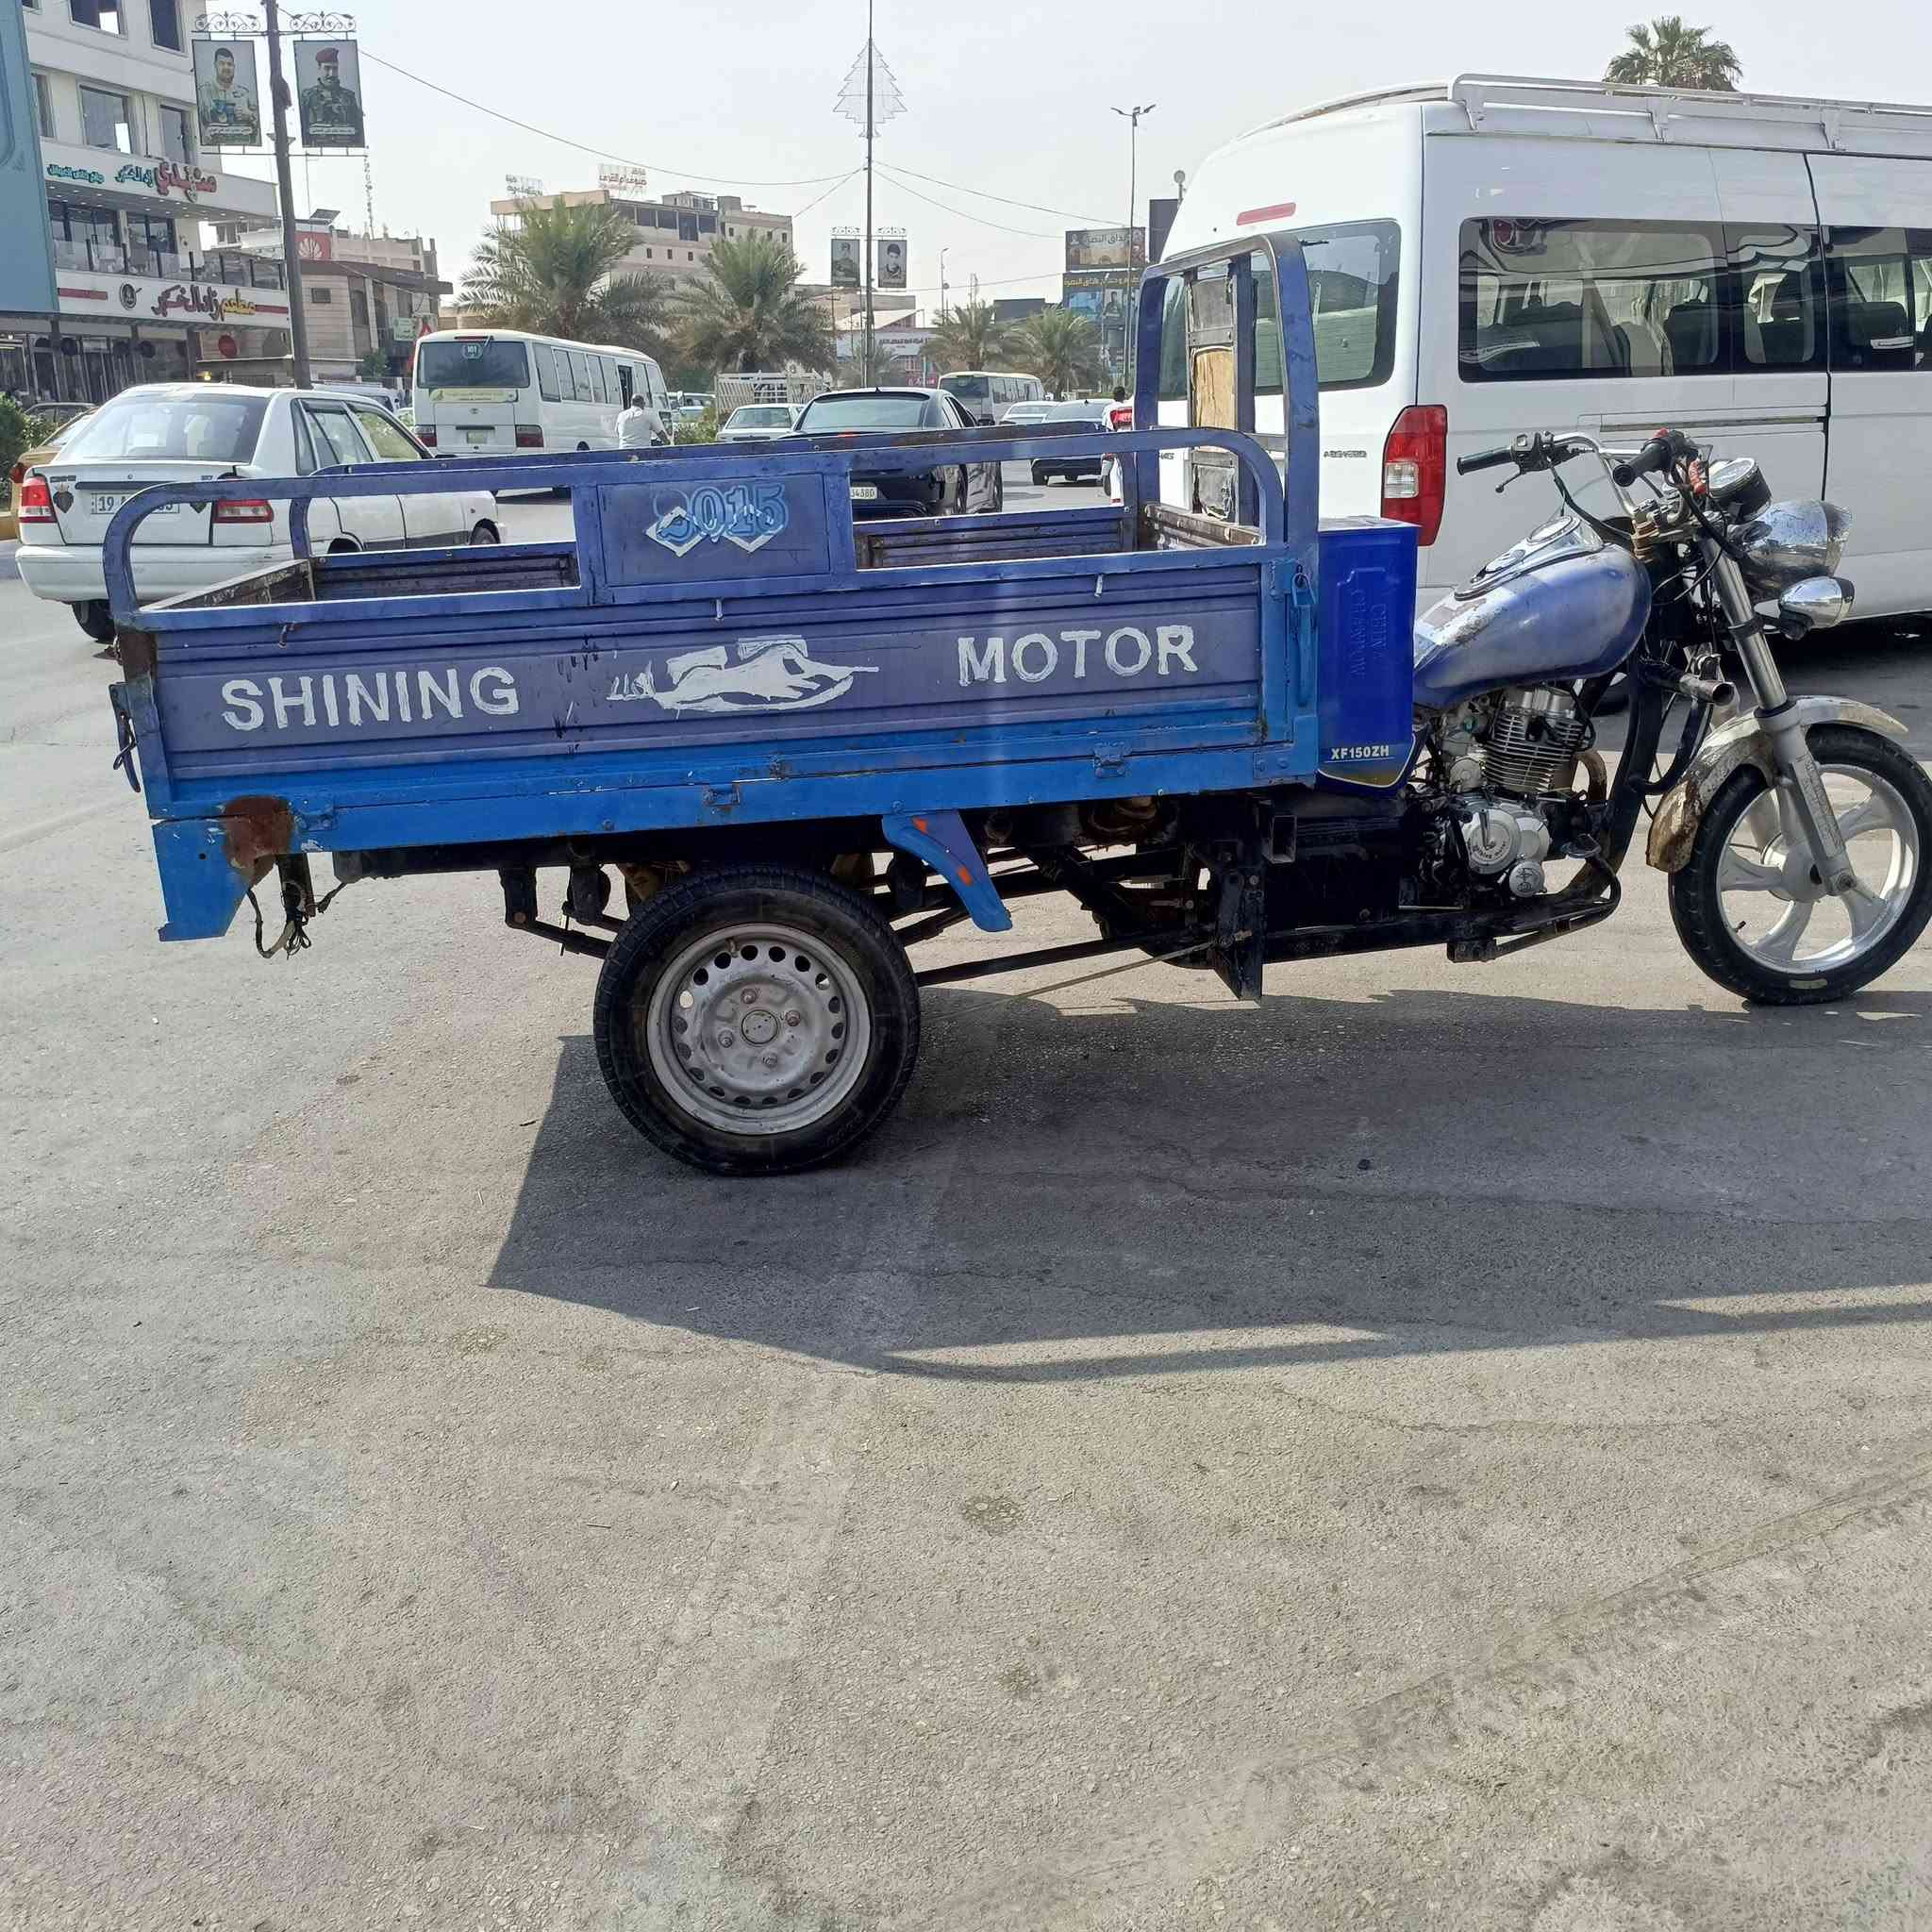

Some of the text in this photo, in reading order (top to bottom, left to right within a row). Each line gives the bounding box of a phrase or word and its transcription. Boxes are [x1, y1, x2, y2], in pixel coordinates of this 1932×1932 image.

[222, 625, 1198, 731] SHINING MOTOR
[1331, 745, 1390, 760] XF150ZH
